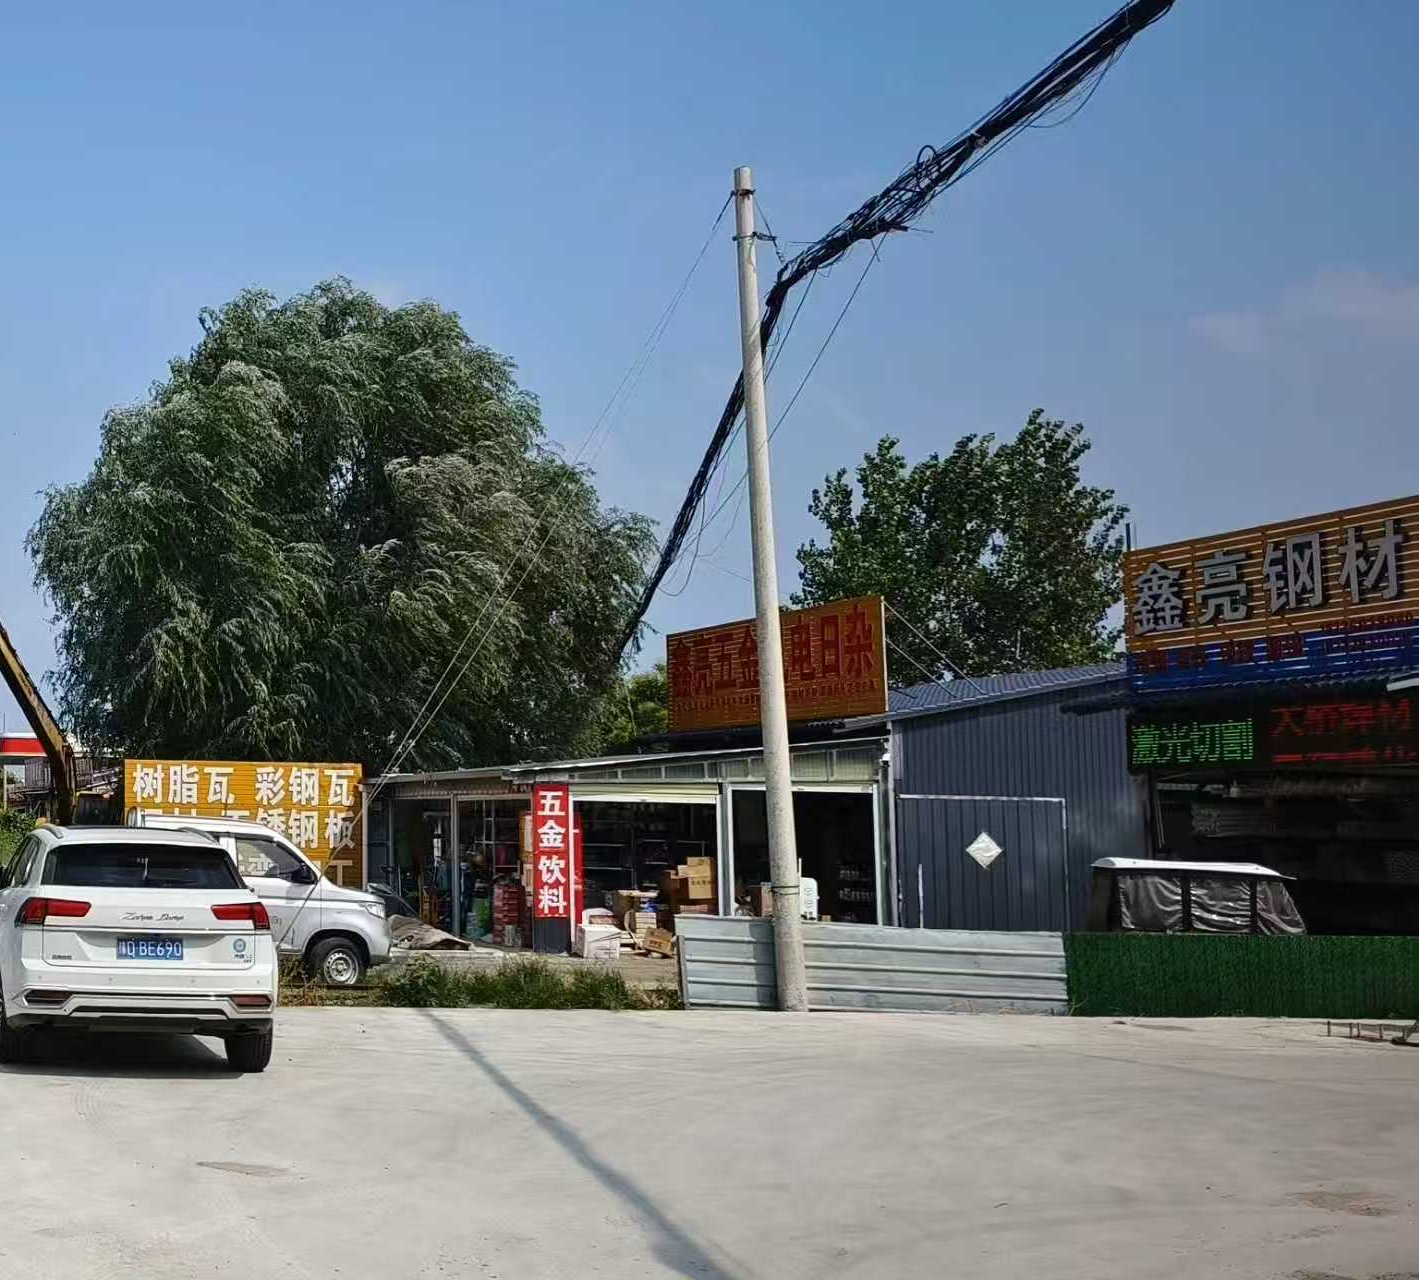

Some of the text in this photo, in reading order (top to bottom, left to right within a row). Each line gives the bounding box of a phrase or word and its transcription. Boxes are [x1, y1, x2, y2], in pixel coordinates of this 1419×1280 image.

[1134, 520, 1403, 634] 鑫亮钢材
[133, 764, 355, 807] 树脂瓦 彩钢瓦
[537, 791, 567, 914] 五金饮料
